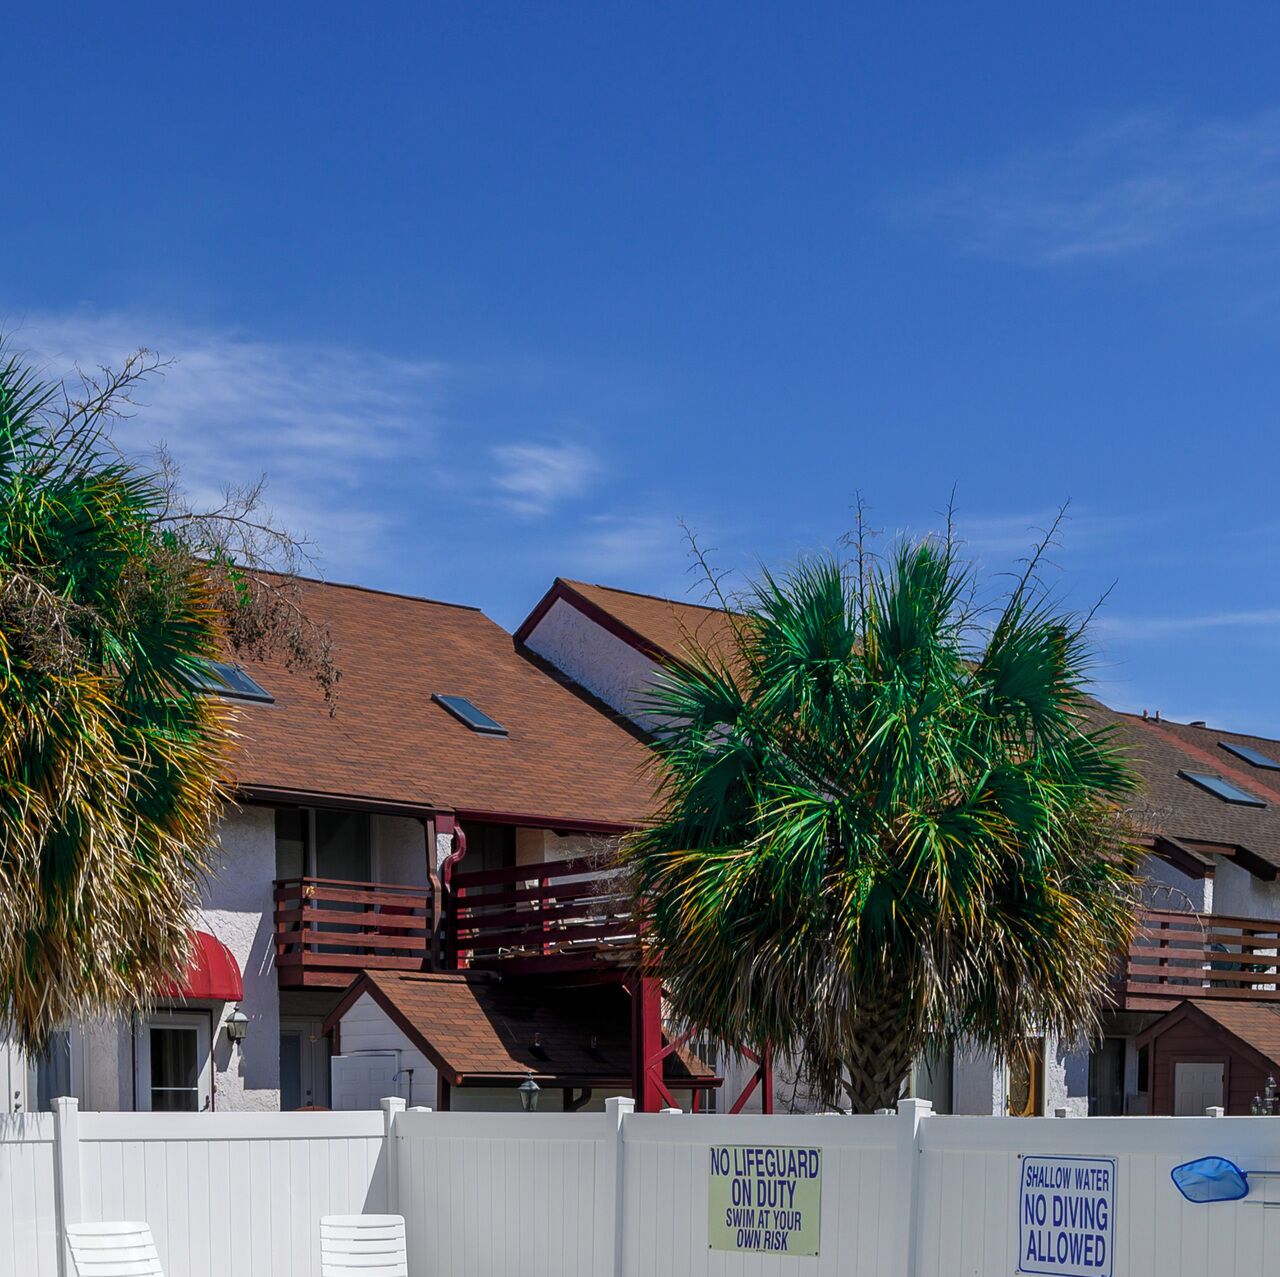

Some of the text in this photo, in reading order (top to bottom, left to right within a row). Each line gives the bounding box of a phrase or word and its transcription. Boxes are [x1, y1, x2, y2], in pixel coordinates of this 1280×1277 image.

[711, 1148, 819, 1178] NO LIFEGUARD
[1026, 1166, 1109, 1191] SHALLOW WATER
[732, 1179, 796, 1208] ON DUTY
[726, 1208, 802, 1231] SWIM AT YOUR
[1025, 1194, 1108, 1231] NO DIVING
[737, 1229, 789, 1251] OWN RISK
[1026, 1230, 1106, 1267] ALLOWED
